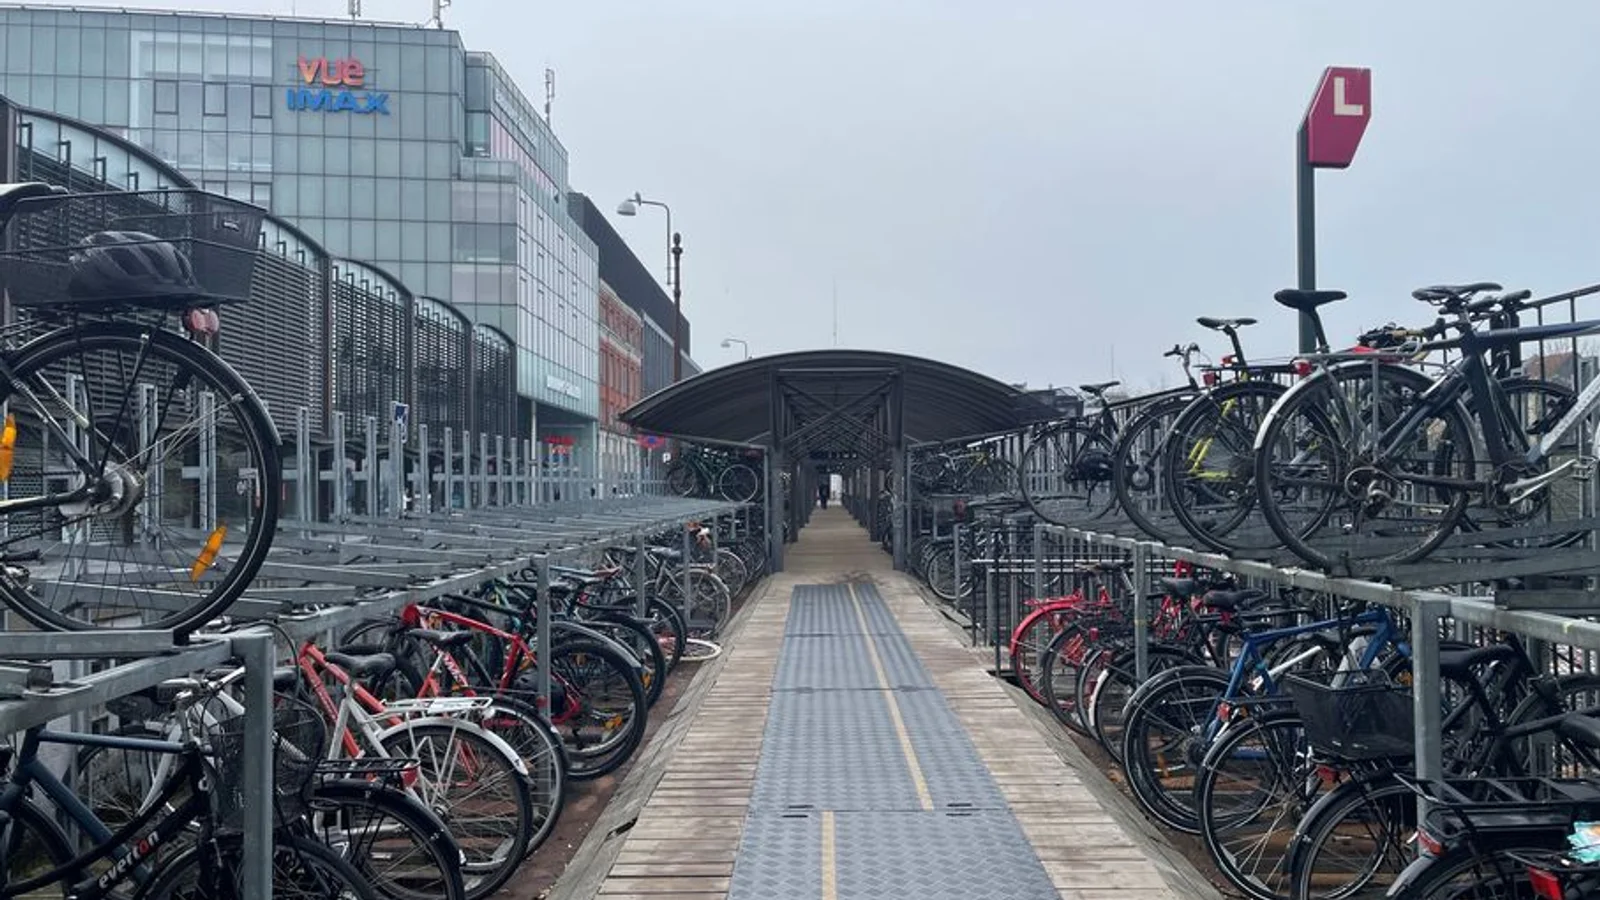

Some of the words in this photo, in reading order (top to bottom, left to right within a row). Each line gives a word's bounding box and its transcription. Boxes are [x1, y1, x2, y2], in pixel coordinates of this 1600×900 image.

[286, 89, 390, 115] IMAX
[1333, 77, 1363, 115] L
[98, 831, 160, 889] everton
